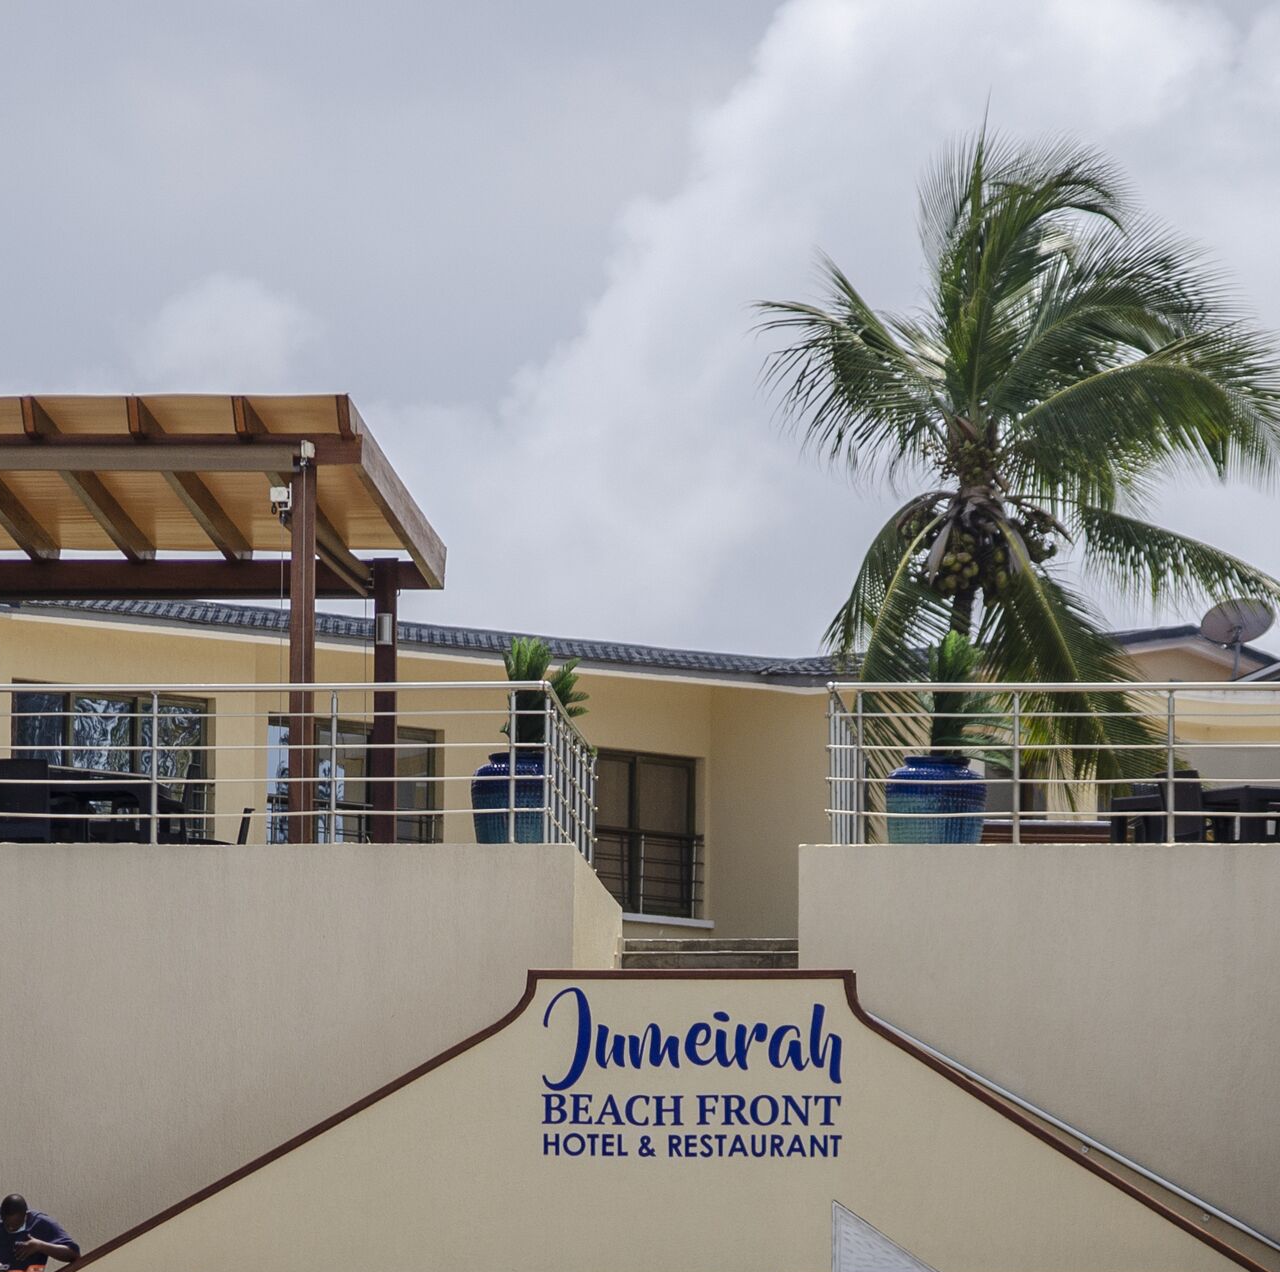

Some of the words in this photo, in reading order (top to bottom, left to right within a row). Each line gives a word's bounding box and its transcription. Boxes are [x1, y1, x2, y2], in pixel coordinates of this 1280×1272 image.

[542, 987, 842, 1091] Jumeirah
[542, 1094, 683, 1126] BEACH
[696, 1094, 841, 1126] FRONT
[543, 1133, 628, 1156] HOTEL
[638, 1134, 656, 1157] &
[668, 1134, 842, 1157] RESTAURANT
